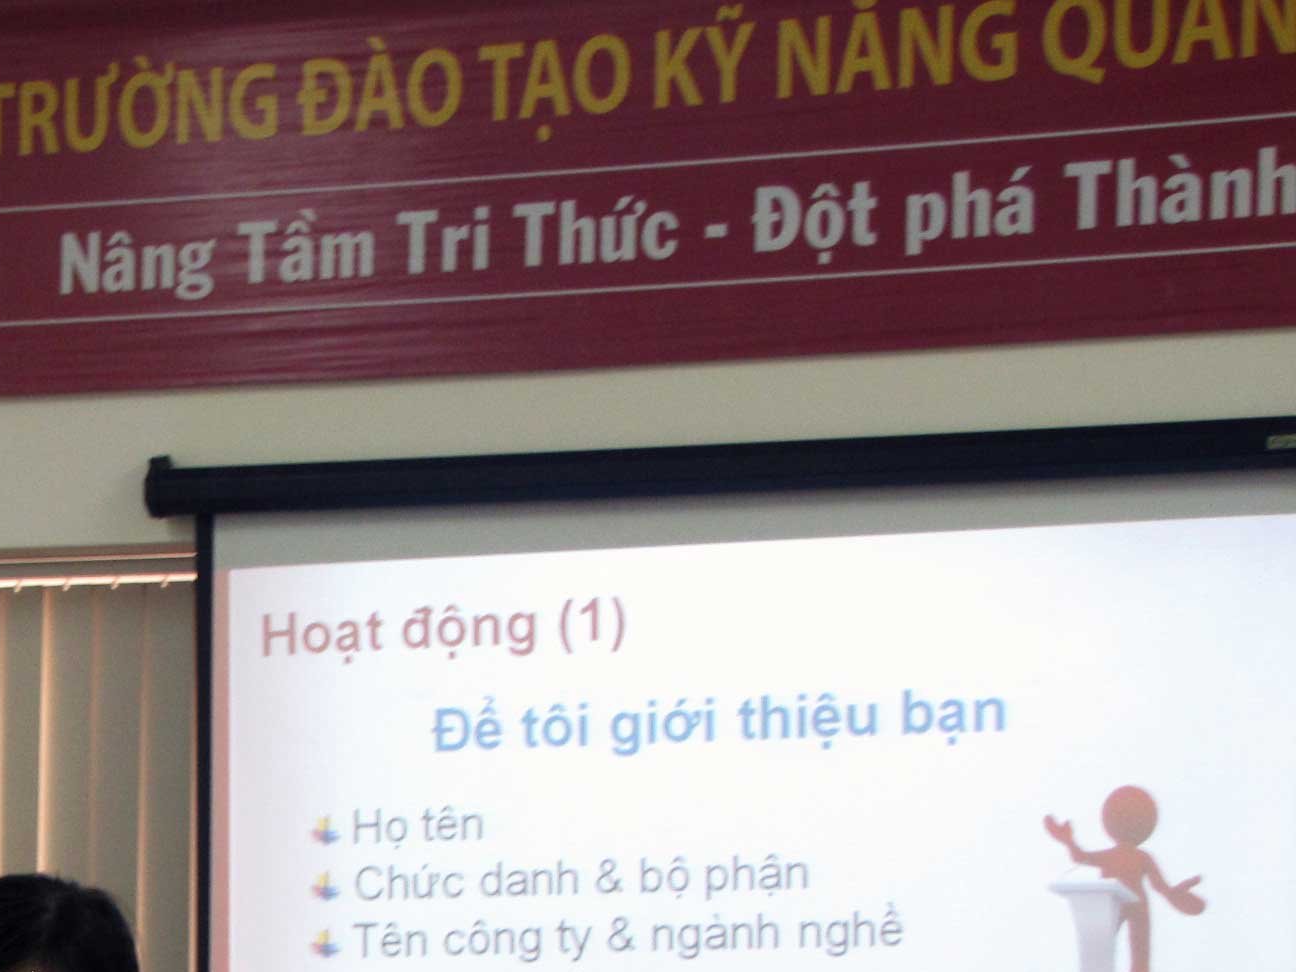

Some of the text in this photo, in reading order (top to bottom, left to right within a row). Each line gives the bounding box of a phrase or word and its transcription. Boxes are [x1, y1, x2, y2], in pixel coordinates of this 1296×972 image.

[297, 36, 462, 136] ĐÀO
[479, 34, 631, 142] TẠO
[653, 4, 755, 110] KỸ
[59, 146, 1296, 300] Nâng Tầm Tri Thức - Đột phá Thành
[262, 597, 626, 665] Hoạt động (1)
[432, 690, 1007, 757] Để tôi giới thiệu bạn
[352, 804, 484, 848] Họ tên
[355, 852, 811, 902] Chức danh & bộ phận
[353, 921, 428, 959] Tên
[443, 916, 542, 962] công
[556, 919, 592, 961] ty
[607, 916, 635, 952] &
